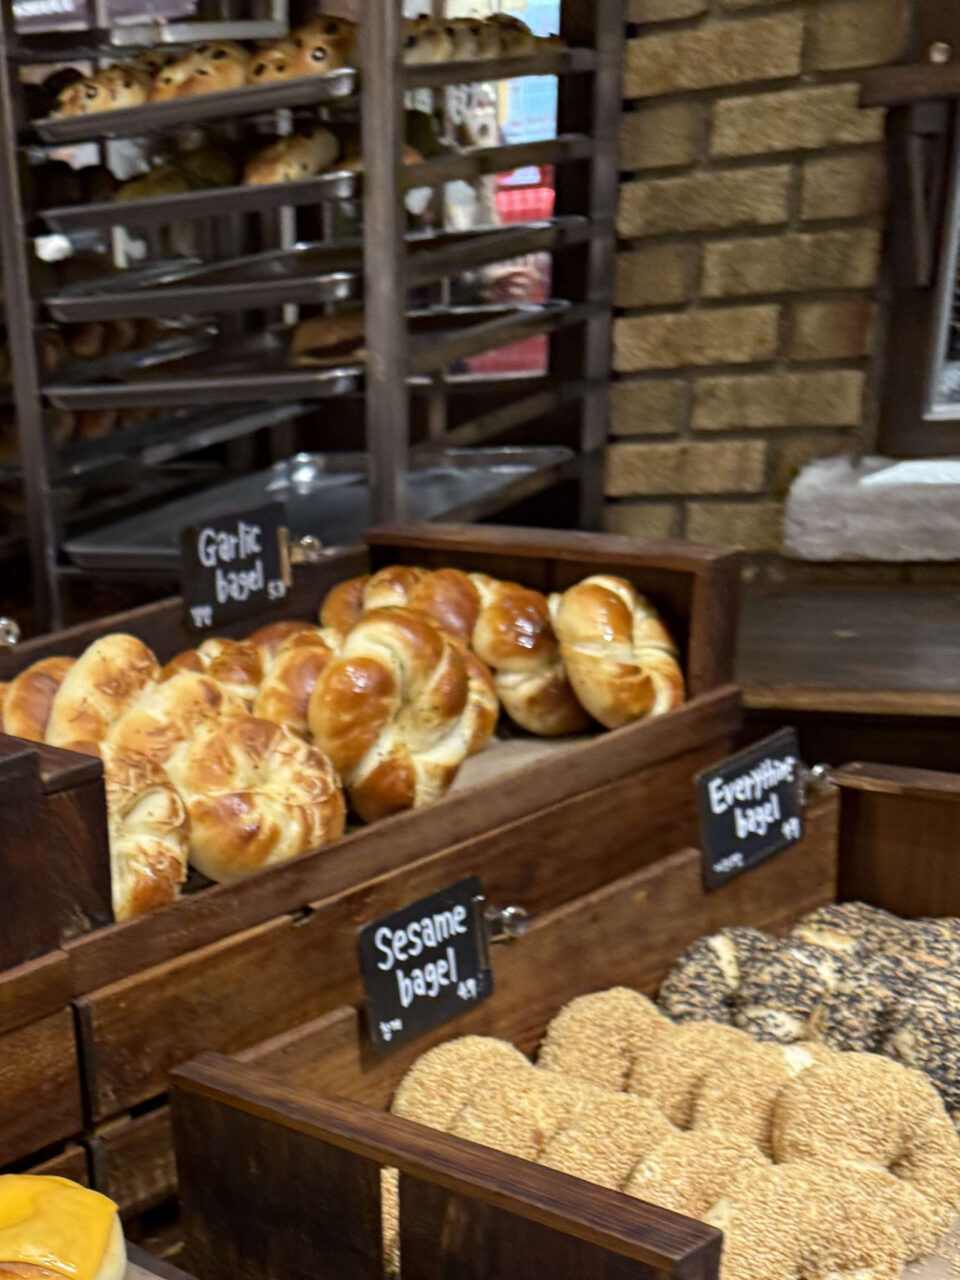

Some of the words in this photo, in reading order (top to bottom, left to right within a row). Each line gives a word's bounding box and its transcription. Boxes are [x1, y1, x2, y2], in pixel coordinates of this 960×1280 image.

[198, 521, 263, 568] Garlic
[216, 559, 265, 603] bagel
[733, 793, 781, 839] bagel
[374, 905, 468, 971] Sesame
[395, 947, 458, 1008] bagel
